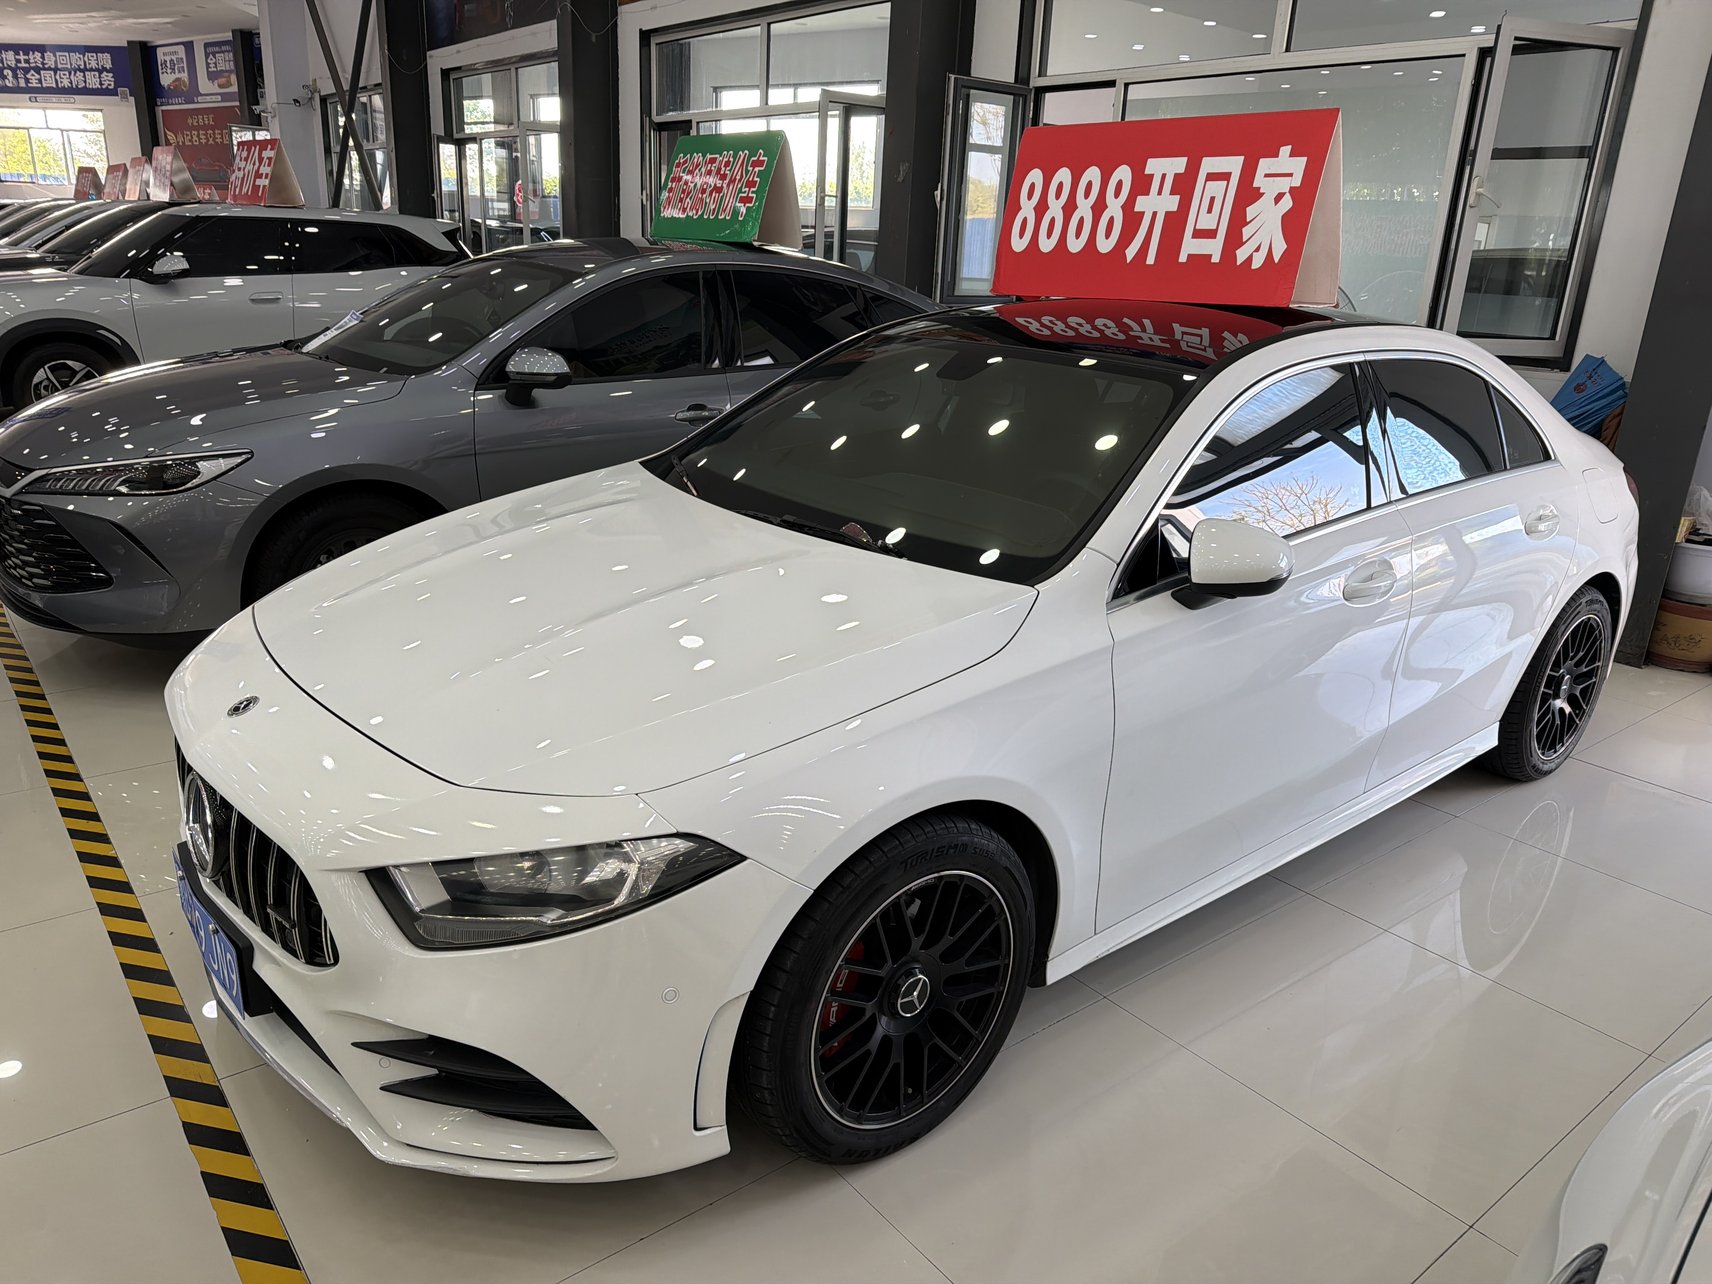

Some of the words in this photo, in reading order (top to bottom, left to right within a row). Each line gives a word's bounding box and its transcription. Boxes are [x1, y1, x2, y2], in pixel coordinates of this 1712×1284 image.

[0, 50, 113, 69] 博士终身回购保障
[231, 144, 275, 197] 特价车
[661, 149, 767, 220] 新能源特价车
[1010, 145, 1307, 269] 8888开回家
